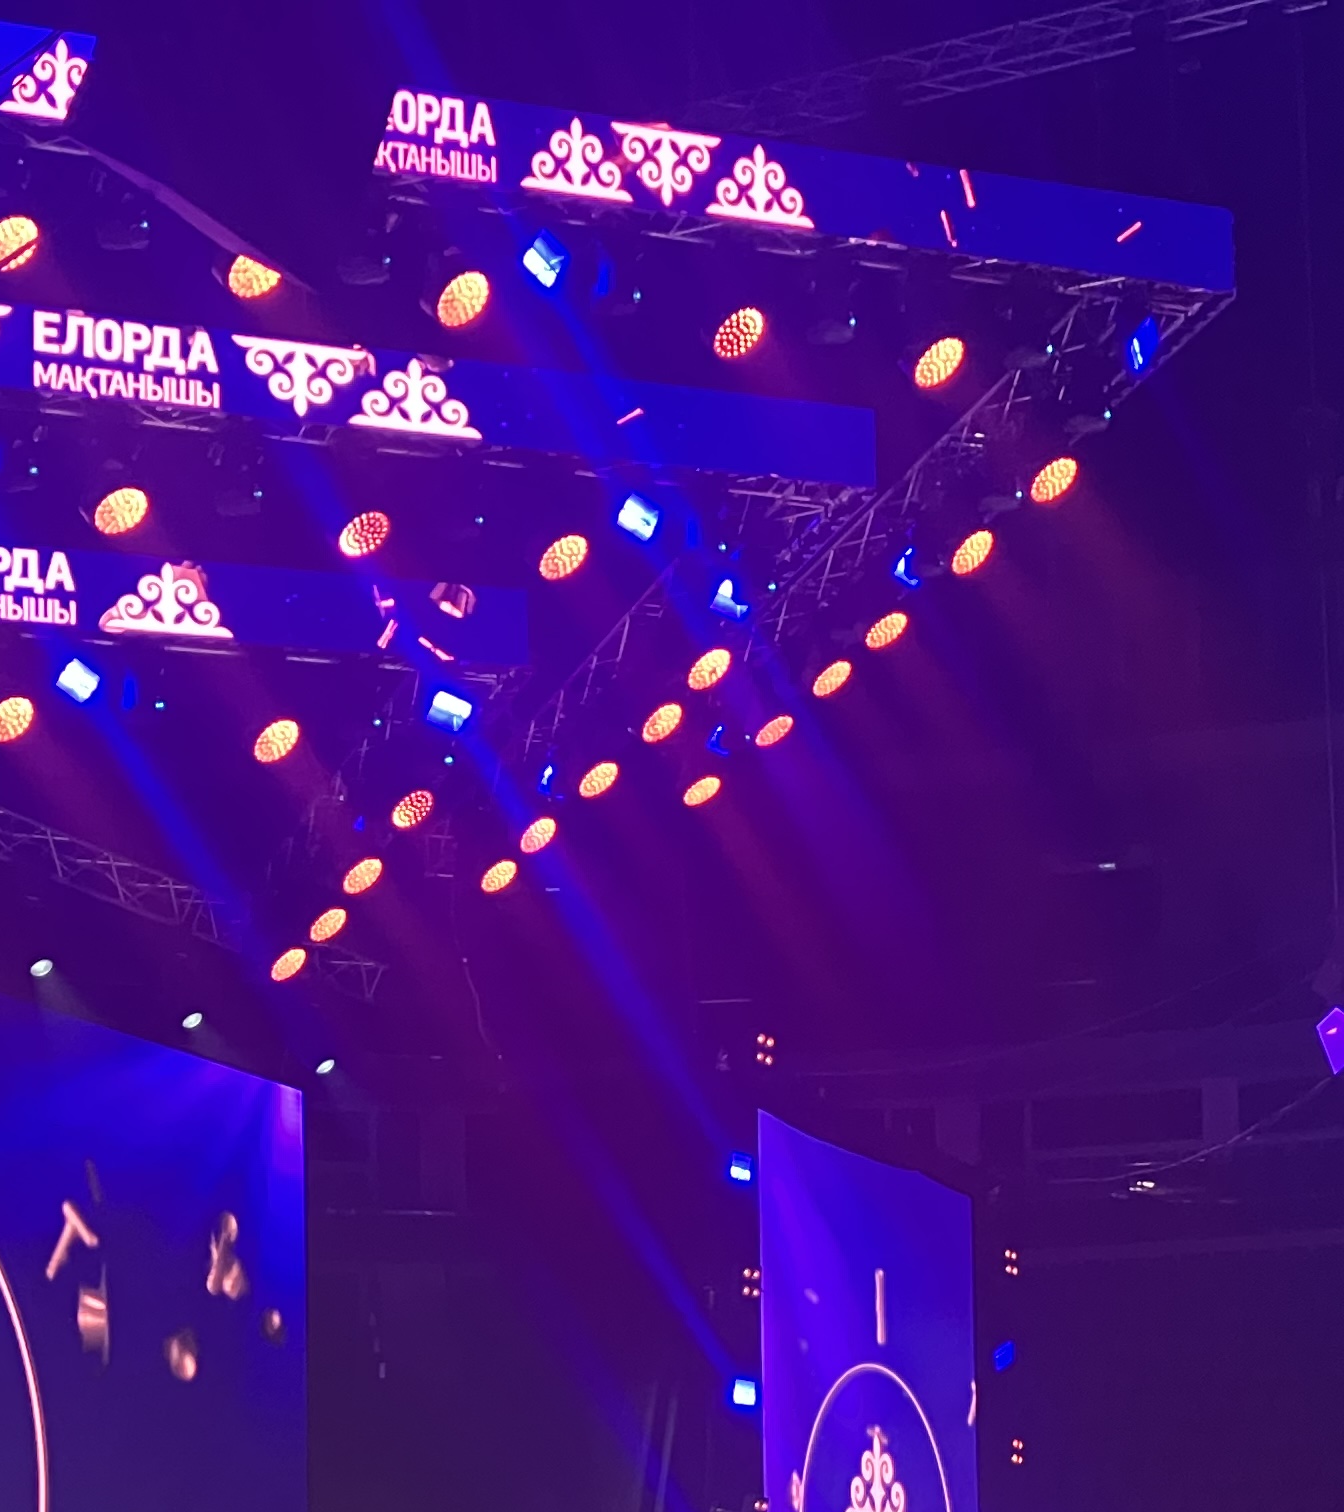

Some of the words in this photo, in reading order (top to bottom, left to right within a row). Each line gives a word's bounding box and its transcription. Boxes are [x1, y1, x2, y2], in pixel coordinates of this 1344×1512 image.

[386, 89, 496, 149] ОРДА
[373, 140, 497, 183] ҚТАНЫШЫ
[33, 310, 219, 375] ЕЛОРДА
[33, 360, 221, 409] МАҚТАНЫШЫ
